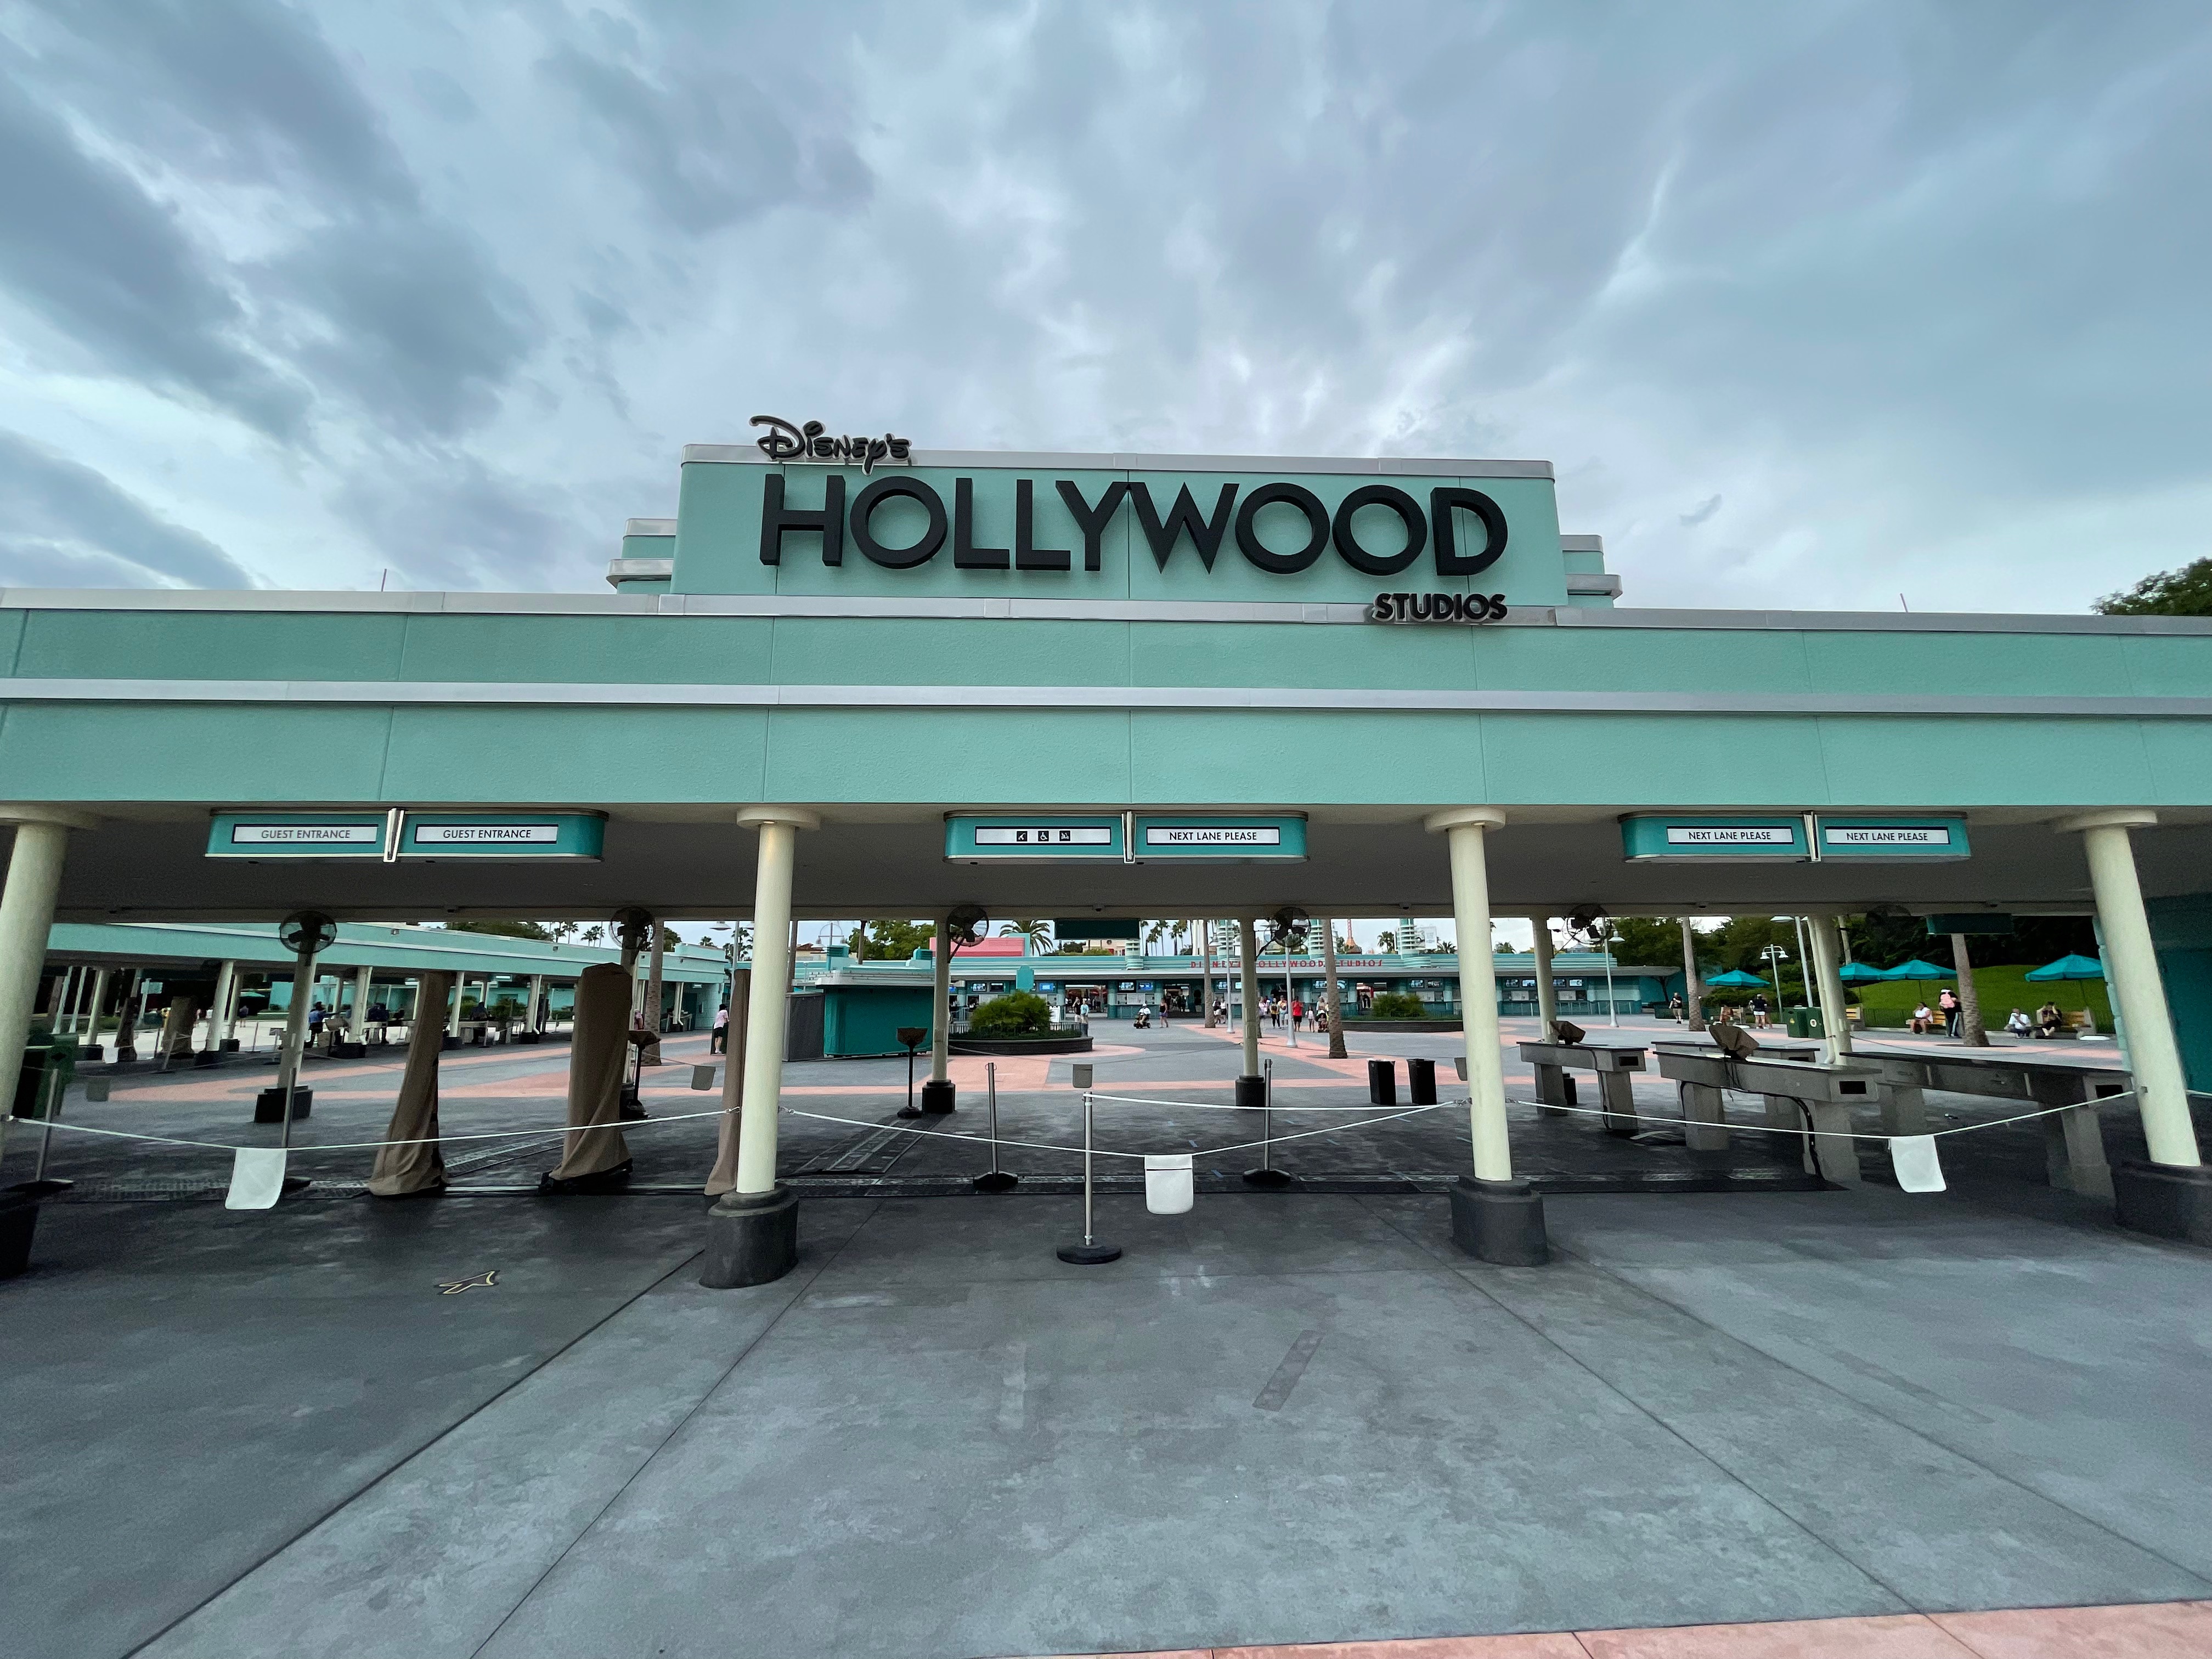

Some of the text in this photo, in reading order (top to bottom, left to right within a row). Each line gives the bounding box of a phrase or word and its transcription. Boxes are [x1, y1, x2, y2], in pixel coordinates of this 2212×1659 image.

[760, 474, 1508, 577] HOLLYWOOD
[1373, 592, 1508, 621] STUDIOS
[261, 830, 351, 839] GUEST ENTRANCE
[443, 829, 532, 838] GUEST ENTRANCE
[1169, 832, 1257, 840] NEXT LANE PLEASE
[1688, 831, 1771, 840] NEXT LANE PLEASE
[1846, 832, 1928, 841] NEXT LANE PLEASE
